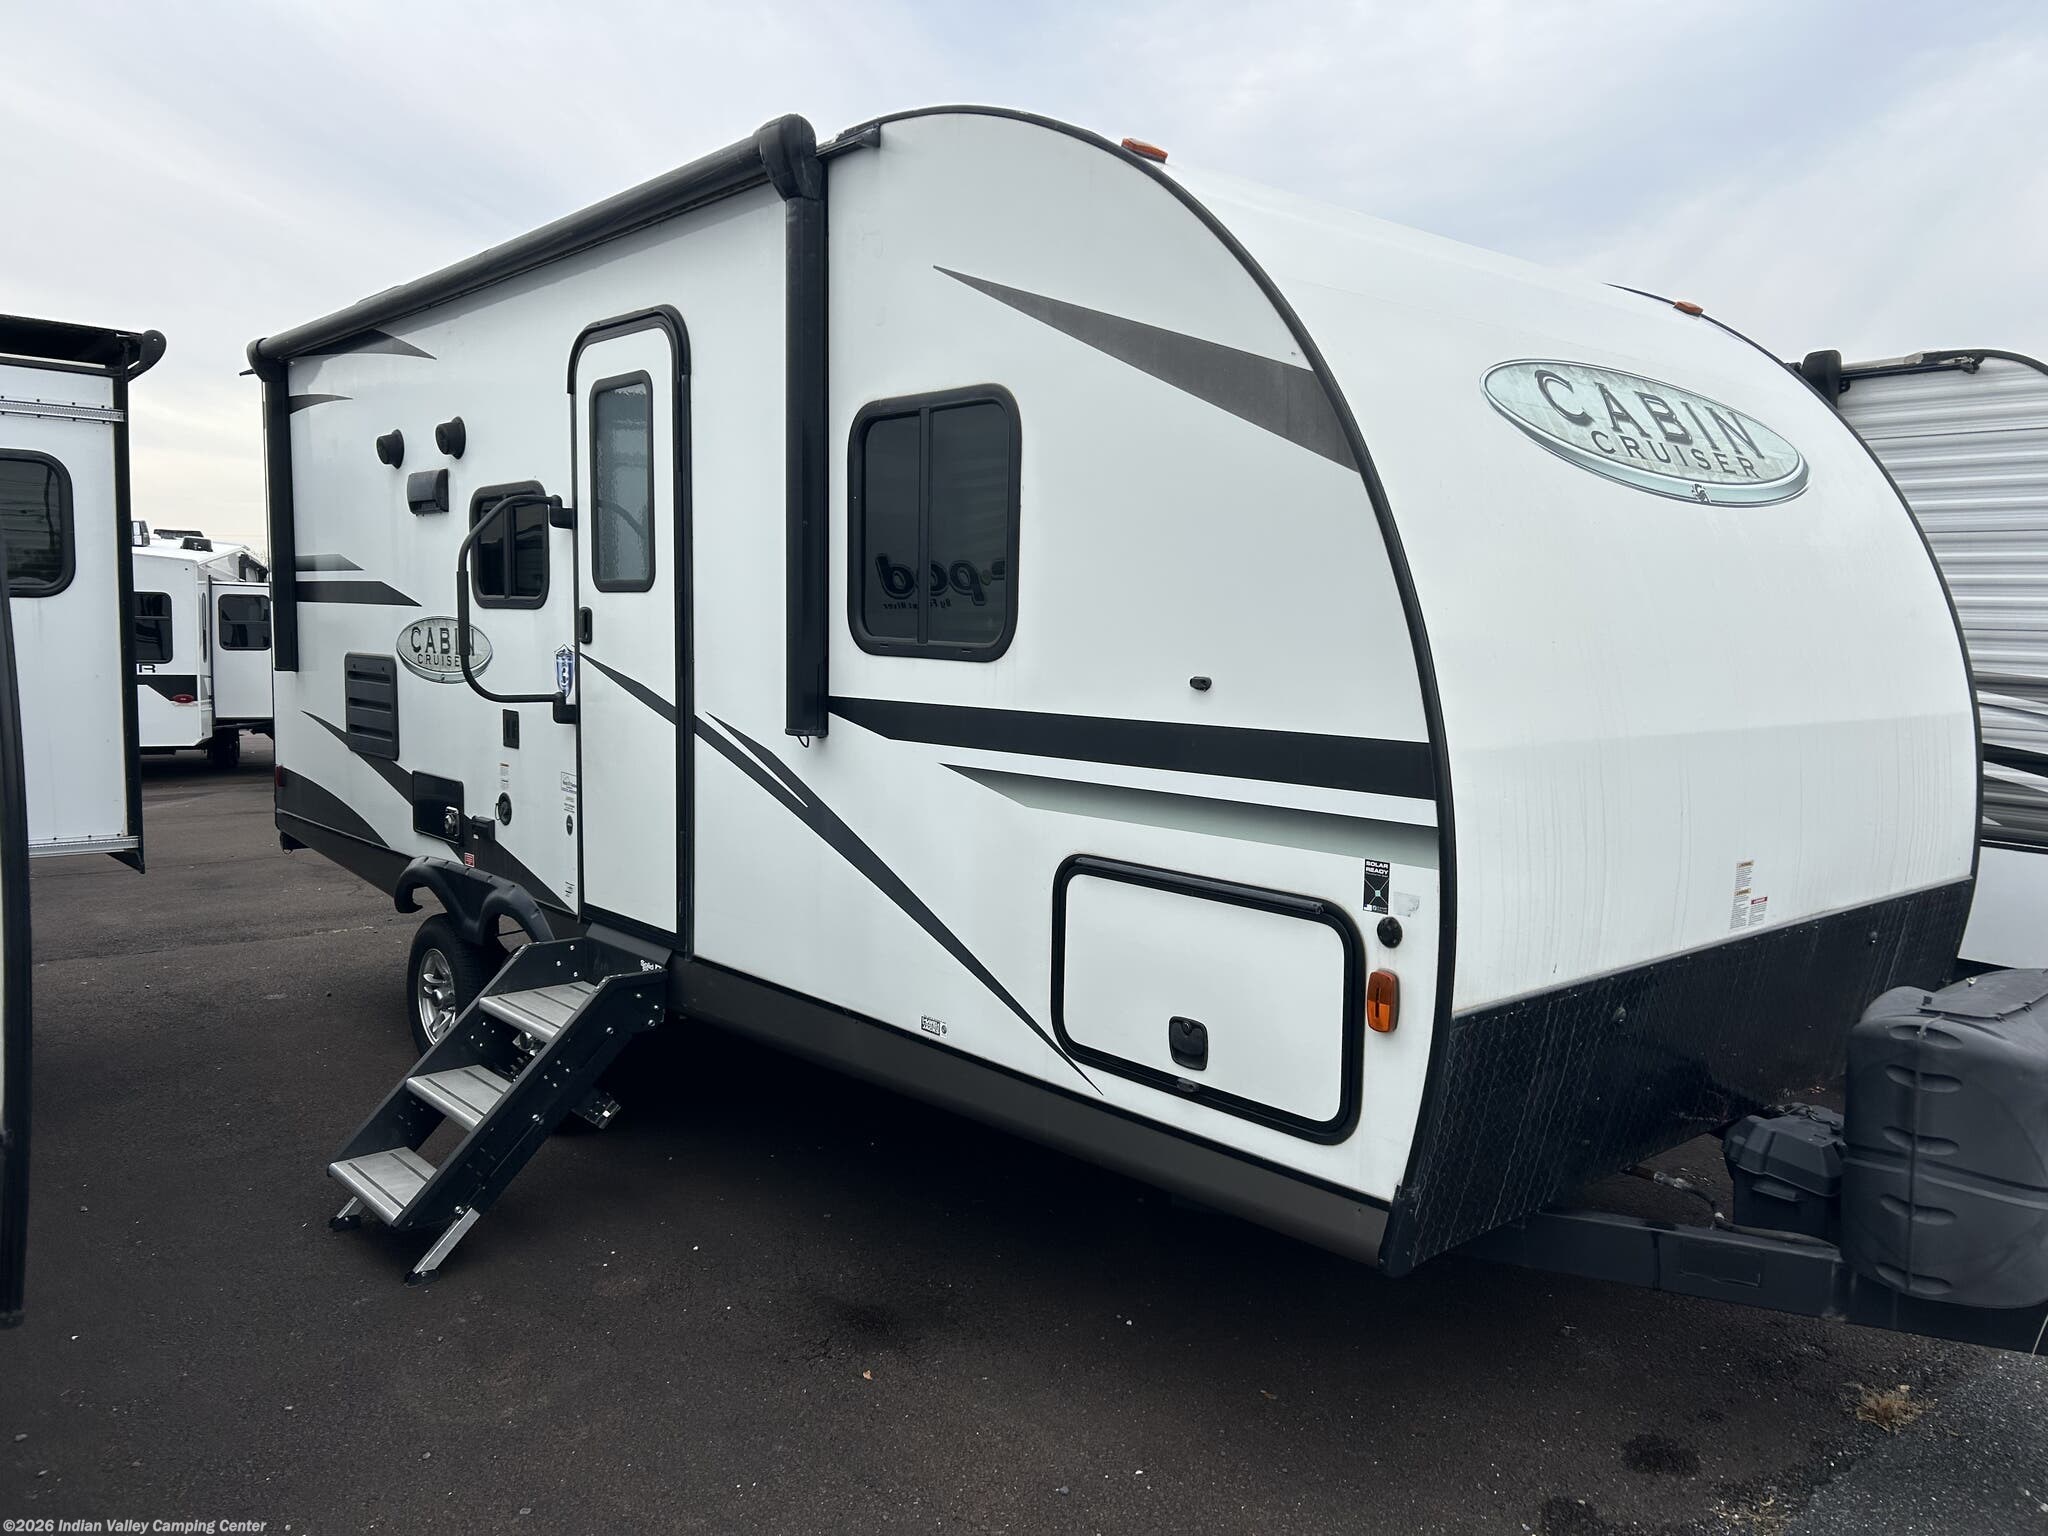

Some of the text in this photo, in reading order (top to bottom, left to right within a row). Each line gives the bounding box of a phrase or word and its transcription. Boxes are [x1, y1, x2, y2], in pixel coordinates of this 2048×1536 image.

[1534, 369, 1765, 459] CABIN
[1591, 430, 1760, 479] CRUISER
[417, 653, 461, 667] CRUISE
[1365, 861, 1388, 869] SOLAR
[1365, 867, 1388, 875] READY
